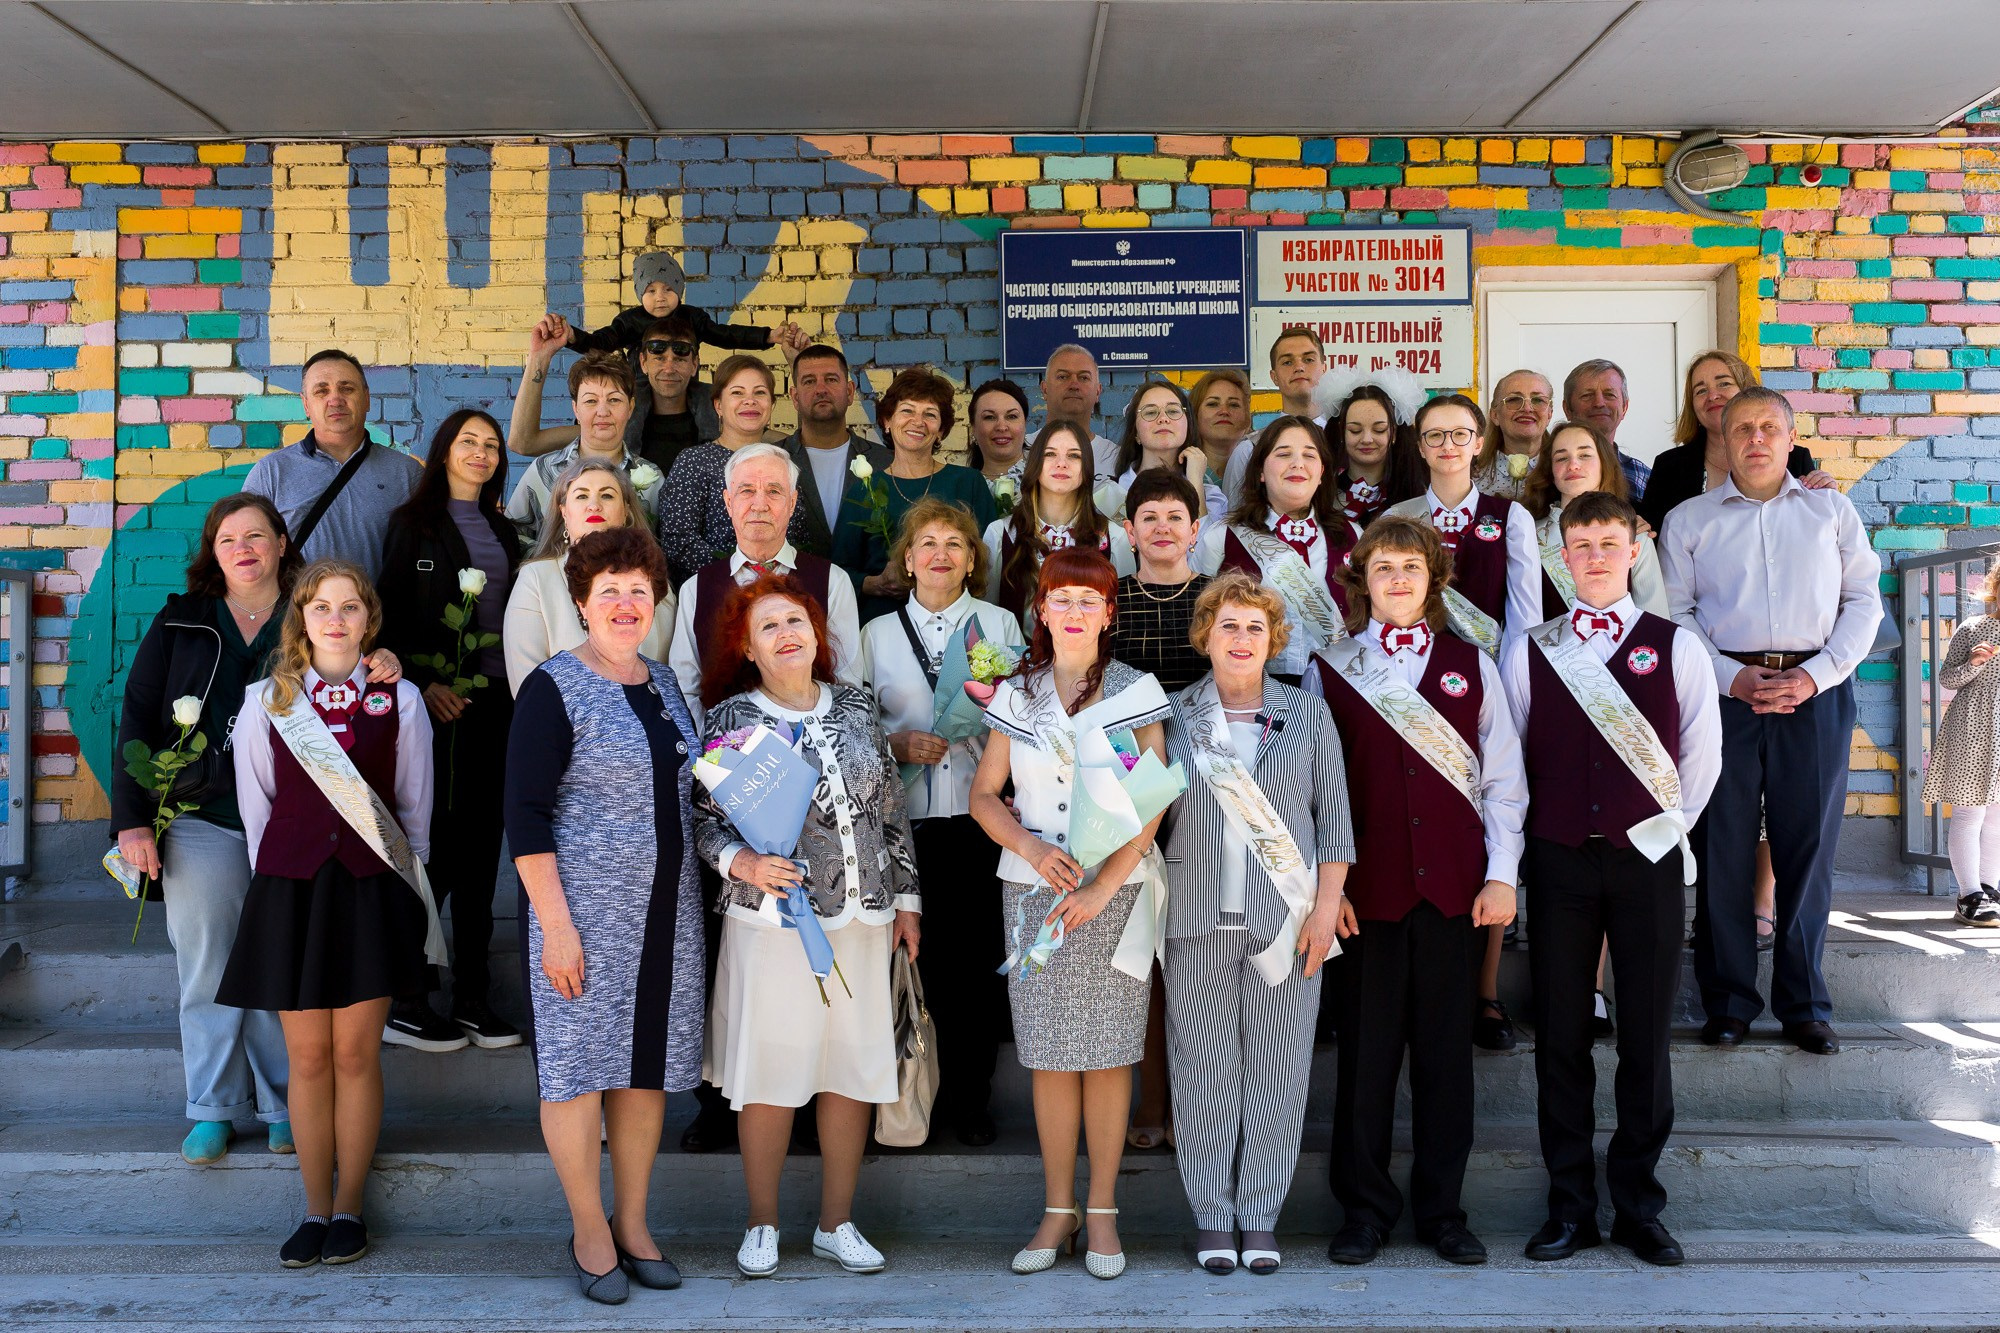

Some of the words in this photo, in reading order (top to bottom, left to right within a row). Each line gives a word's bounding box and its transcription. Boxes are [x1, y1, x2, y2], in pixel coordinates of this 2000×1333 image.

[1071, 259, 1120, 267] Министерство
[1121, 258, 1165, 267] образования
[1165, 257, 1176, 266] РФ
[1282, 235, 1443, 262] ИЗБИРАТЕЛЬНЫЙ
[1006, 282, 1050, 298] ЧАСТНОЕ
[1051, 281, 1175, 298] ОБЩЕОБРАЗОВАТЕЛЬНОЕ
[1176, 279, 1241, 296] УЧРЕЖДЕНИЕ
[1284, 272, 1360, 293] УЧАСТОК
[1368, 273, 1389, 292] №
[1395, 266, 1445, 292] 3014
[1007, 303, 1058, 321] СРЕДНЯЯ
[1060, 301, 1197, 319] ОБЩЕОБРАЗОВАТЕЛЬНАЯ
[1198, 301, 1240, 315] ШКОЛА
[1110, 352, 1148, 361] Славянка
[1395, 350, 1442, 374] 3024
[1566, 664, 1662, 775] Выпускник
[1376, 686, 1477, 784] Выпускник
[742, 753, 782, 796] sight
[1254, 832, 1302, 876] 2023
